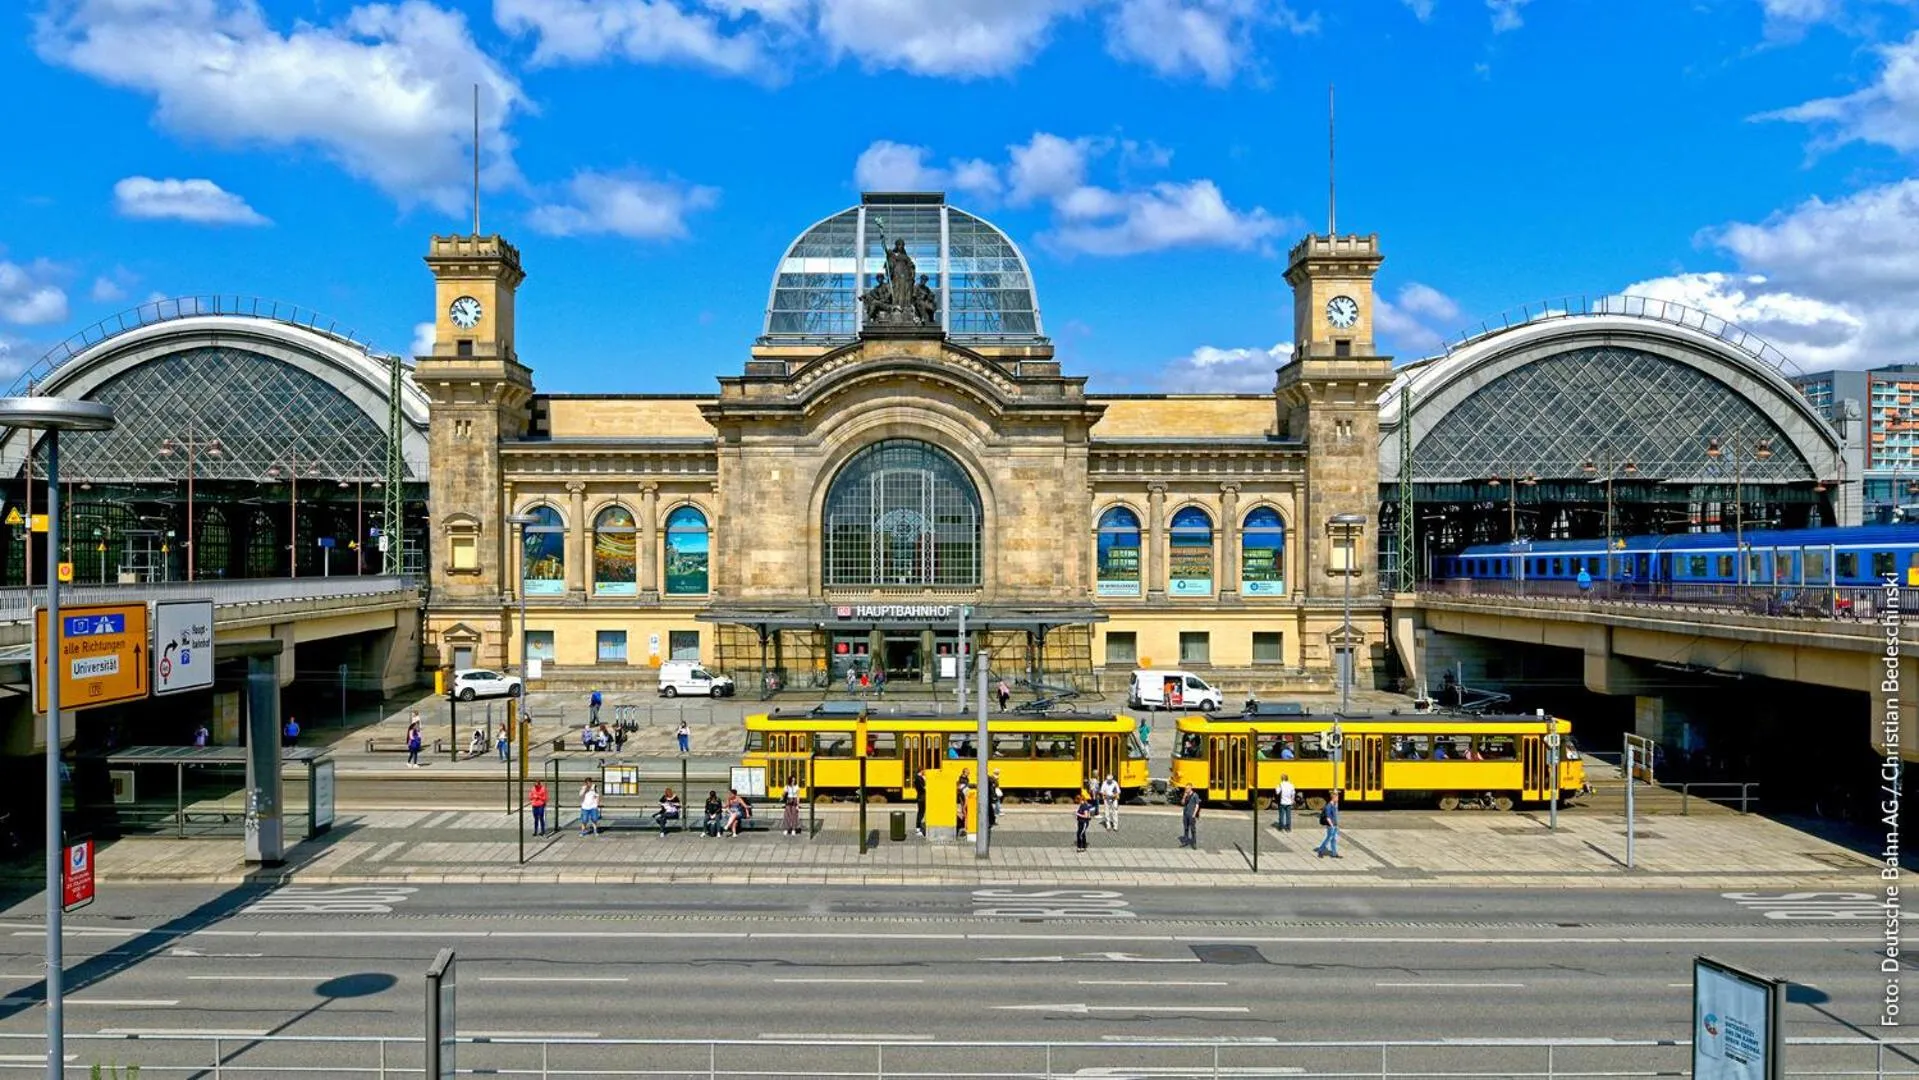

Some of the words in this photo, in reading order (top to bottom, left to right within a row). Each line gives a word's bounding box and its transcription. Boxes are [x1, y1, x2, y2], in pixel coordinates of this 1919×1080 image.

[856, 605, 954, 617] HAUPTBAHNHOF
[64, 642, 80, 655] alle
[82, 640, 125, 653] Richtungen
[73, 658, 117, 675] Universität
